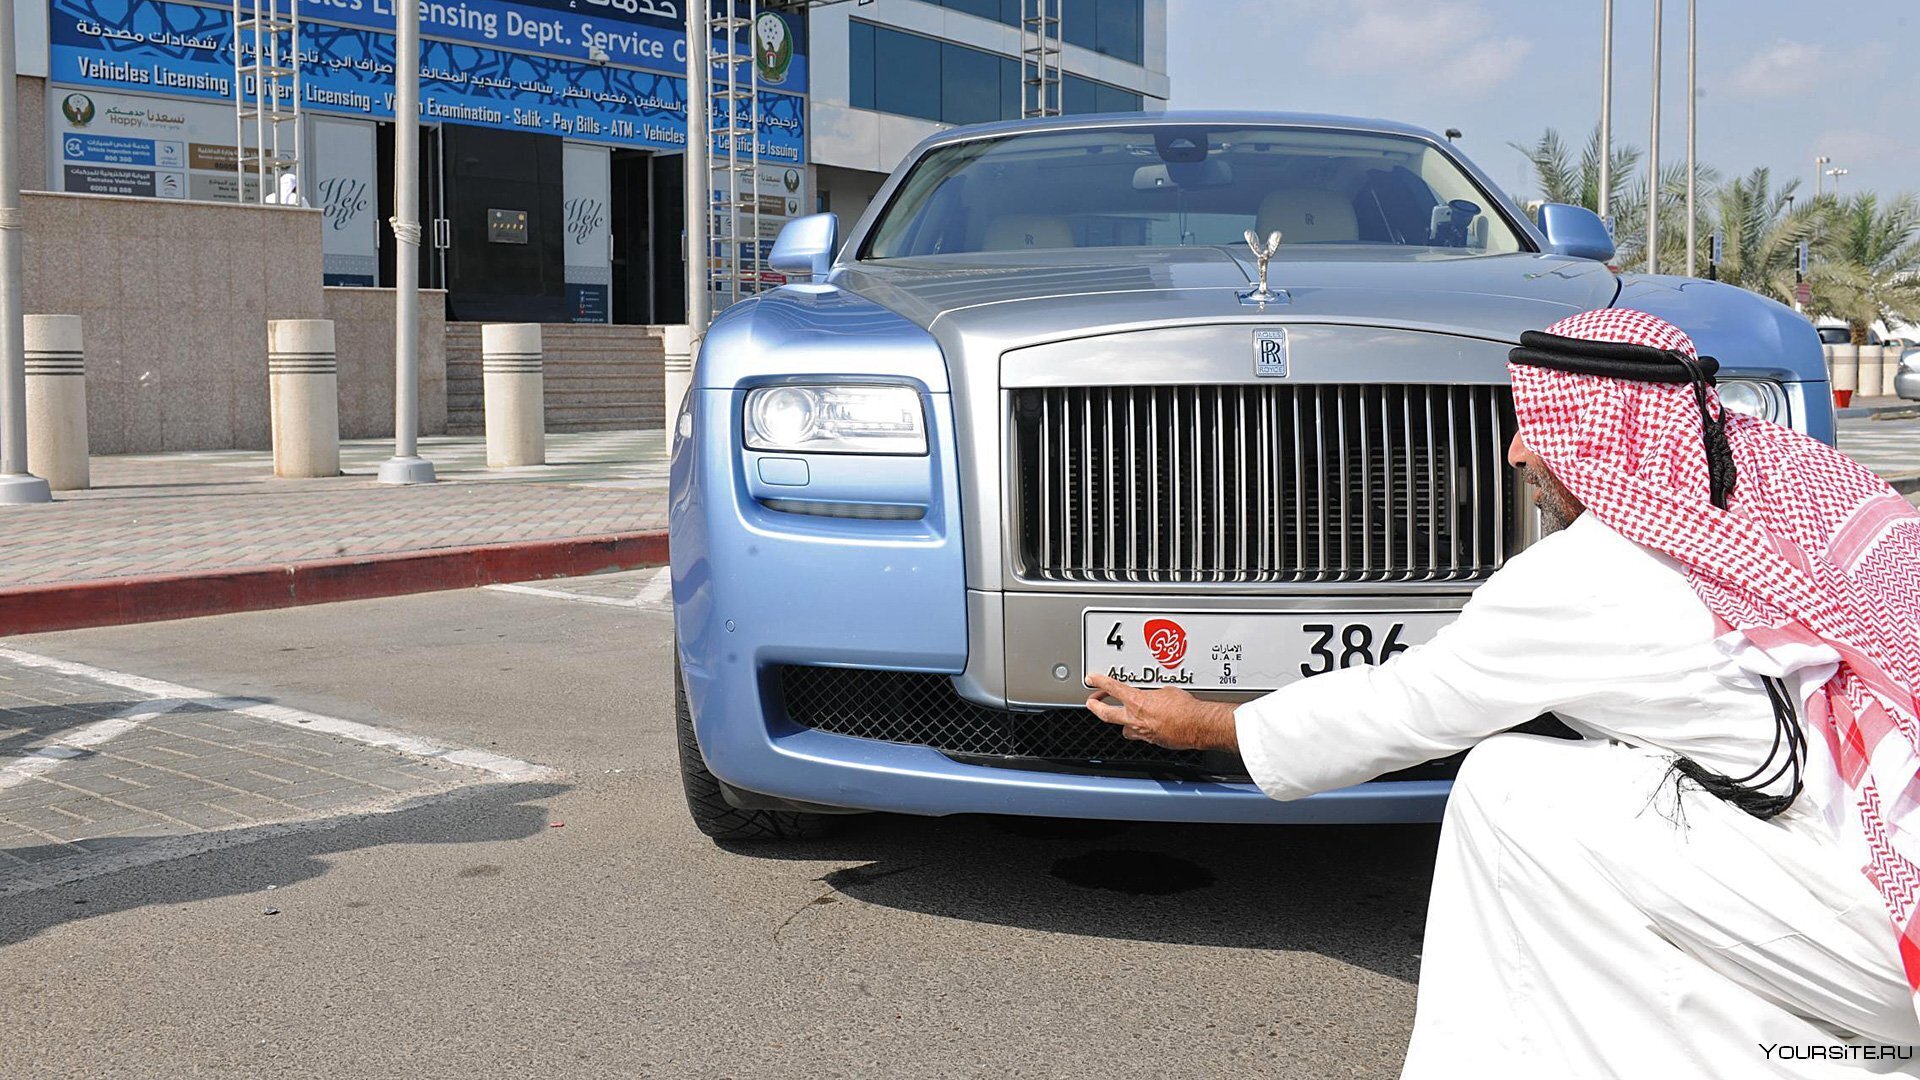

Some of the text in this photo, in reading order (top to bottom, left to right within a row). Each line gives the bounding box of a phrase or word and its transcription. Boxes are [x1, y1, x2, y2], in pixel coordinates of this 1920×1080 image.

[76, 20, 144, 42] مصدقة
[373, 0, 498, 39] Liensing
[506, 10, 571, 47] Dept.
[581, 23, 664, 58] Service
[149, 31, 217, 50] شهادات
[354, 58, 393, 74] صراف
[419, 65, 467, 83] المخالف
[78, 56, 149, 83] Vehicles
[154, 64, 229, 96] Licensing
[306, 82, 371, 112] Licensing
[110, 114, 142, 128] Happy
[427, 97, 502, 123] Examination
[513, 108, 542, 128] Salik
[553, 112, 573, 134] Pay
[576, 116, 600, 134] Bills
[610, 119, 633, 138] ATM
[643, 123, 685, 144] Vehicles
[69, 143, 80, 151] 24
[768, 140, 799, 160] Issuing
[1260, 340, 1282, 364] RR
[1106, 621, 1124, 651] 4
[1108, 666, 1195, 684] Abu Dhabi
[1223, 663, 1232, 677] 5
[1219, 676, 1237, 685] 2016
